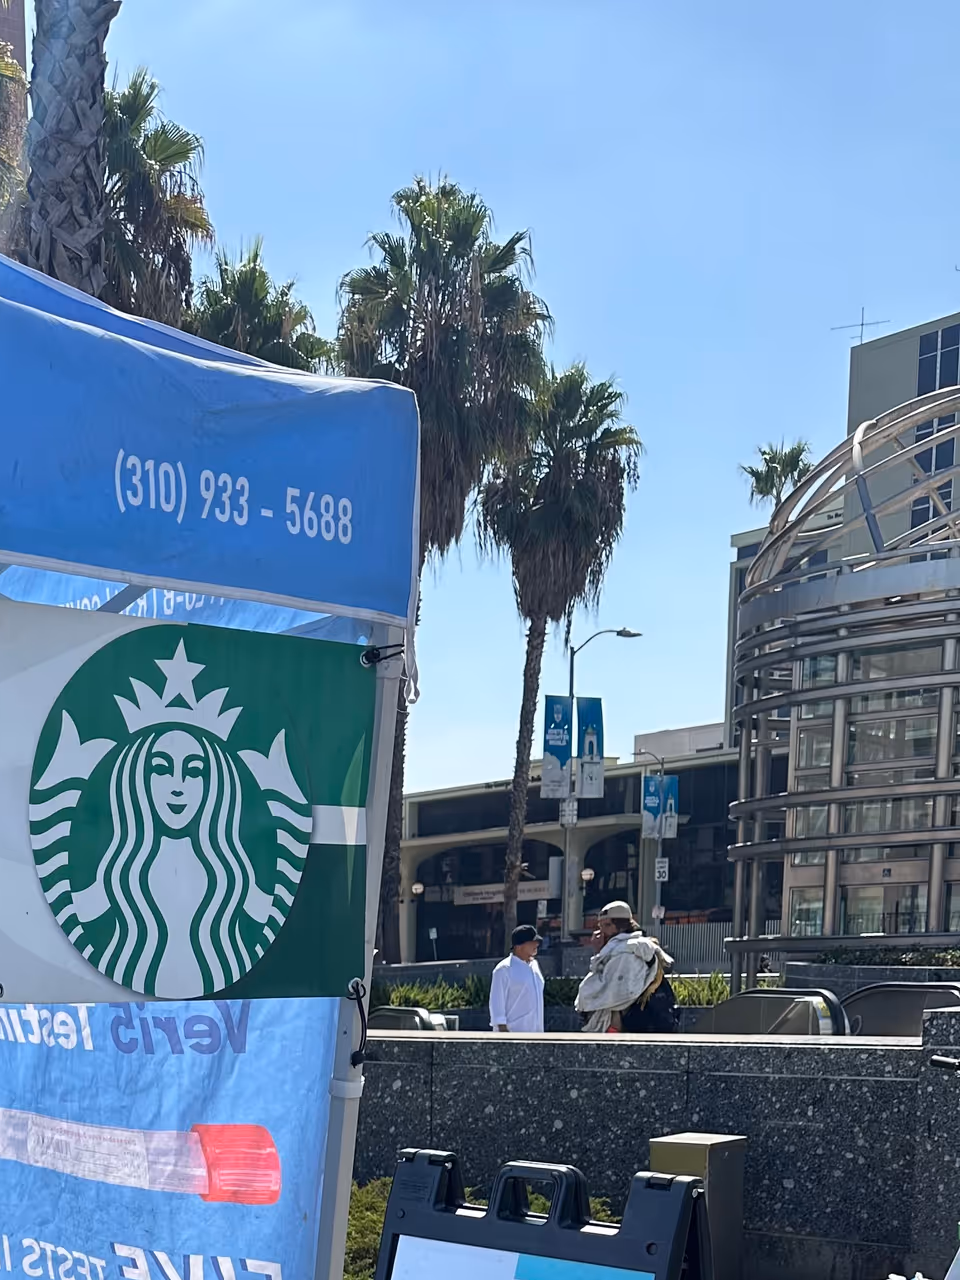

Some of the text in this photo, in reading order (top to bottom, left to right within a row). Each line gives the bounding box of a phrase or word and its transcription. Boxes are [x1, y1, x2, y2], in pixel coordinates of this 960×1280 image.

[114, 448, 187, 524] (310)
[199, 469, 249, 526] 933
[285, 486, 353, 545] 5688
[656, 870, 667, 880] 30
